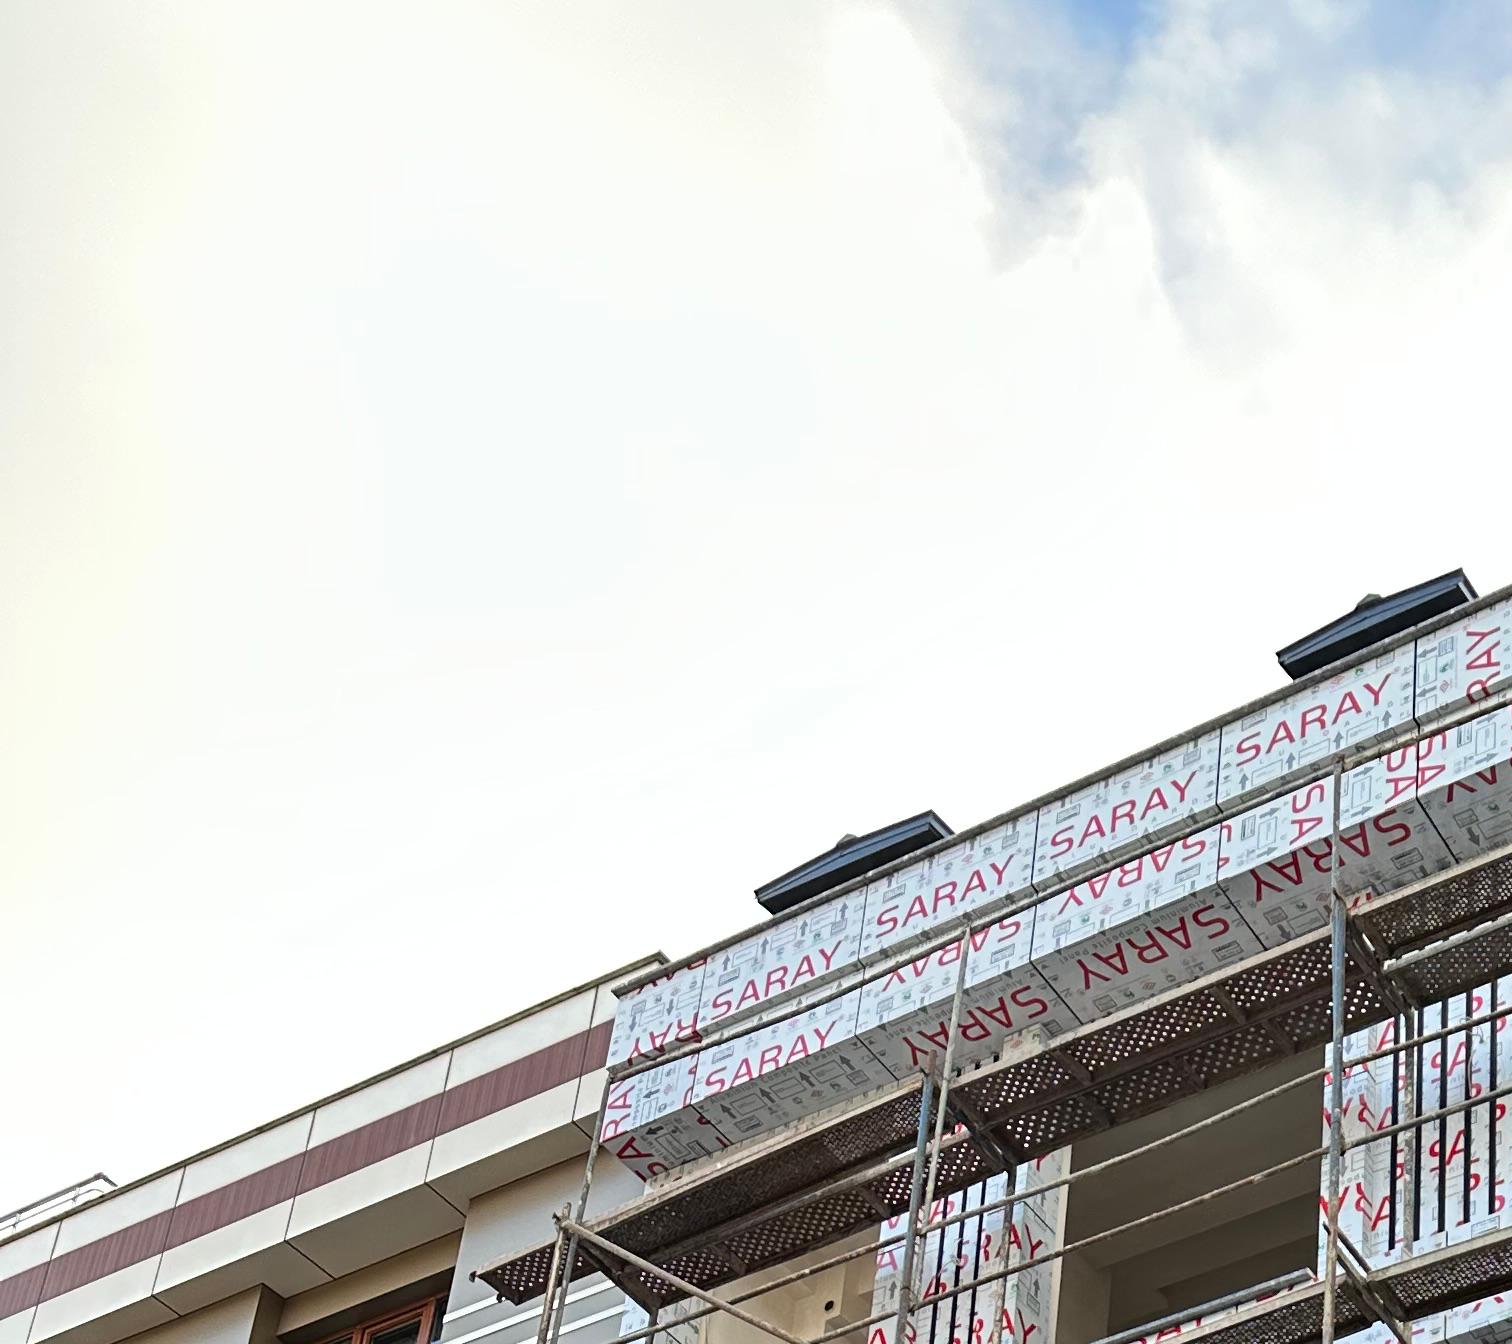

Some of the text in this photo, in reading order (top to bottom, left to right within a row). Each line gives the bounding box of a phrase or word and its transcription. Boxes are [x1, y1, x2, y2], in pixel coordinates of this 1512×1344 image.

[1236, 673, 1392, 767] SARAY
[1050, 770, 1197, 859] SARAY
[1250, 808, 1411, 901] SARAY
[876, 854, 1014, 938] SARAY
[1058, 835, 1206, 915] SARAY
[711, 940, 843, 1020] SARAY
[1077, 903, 1230, 990] SARAY
[705, 1021, 838, 1097] SARAY
[903, 985, 1048, 1066] SARAY
